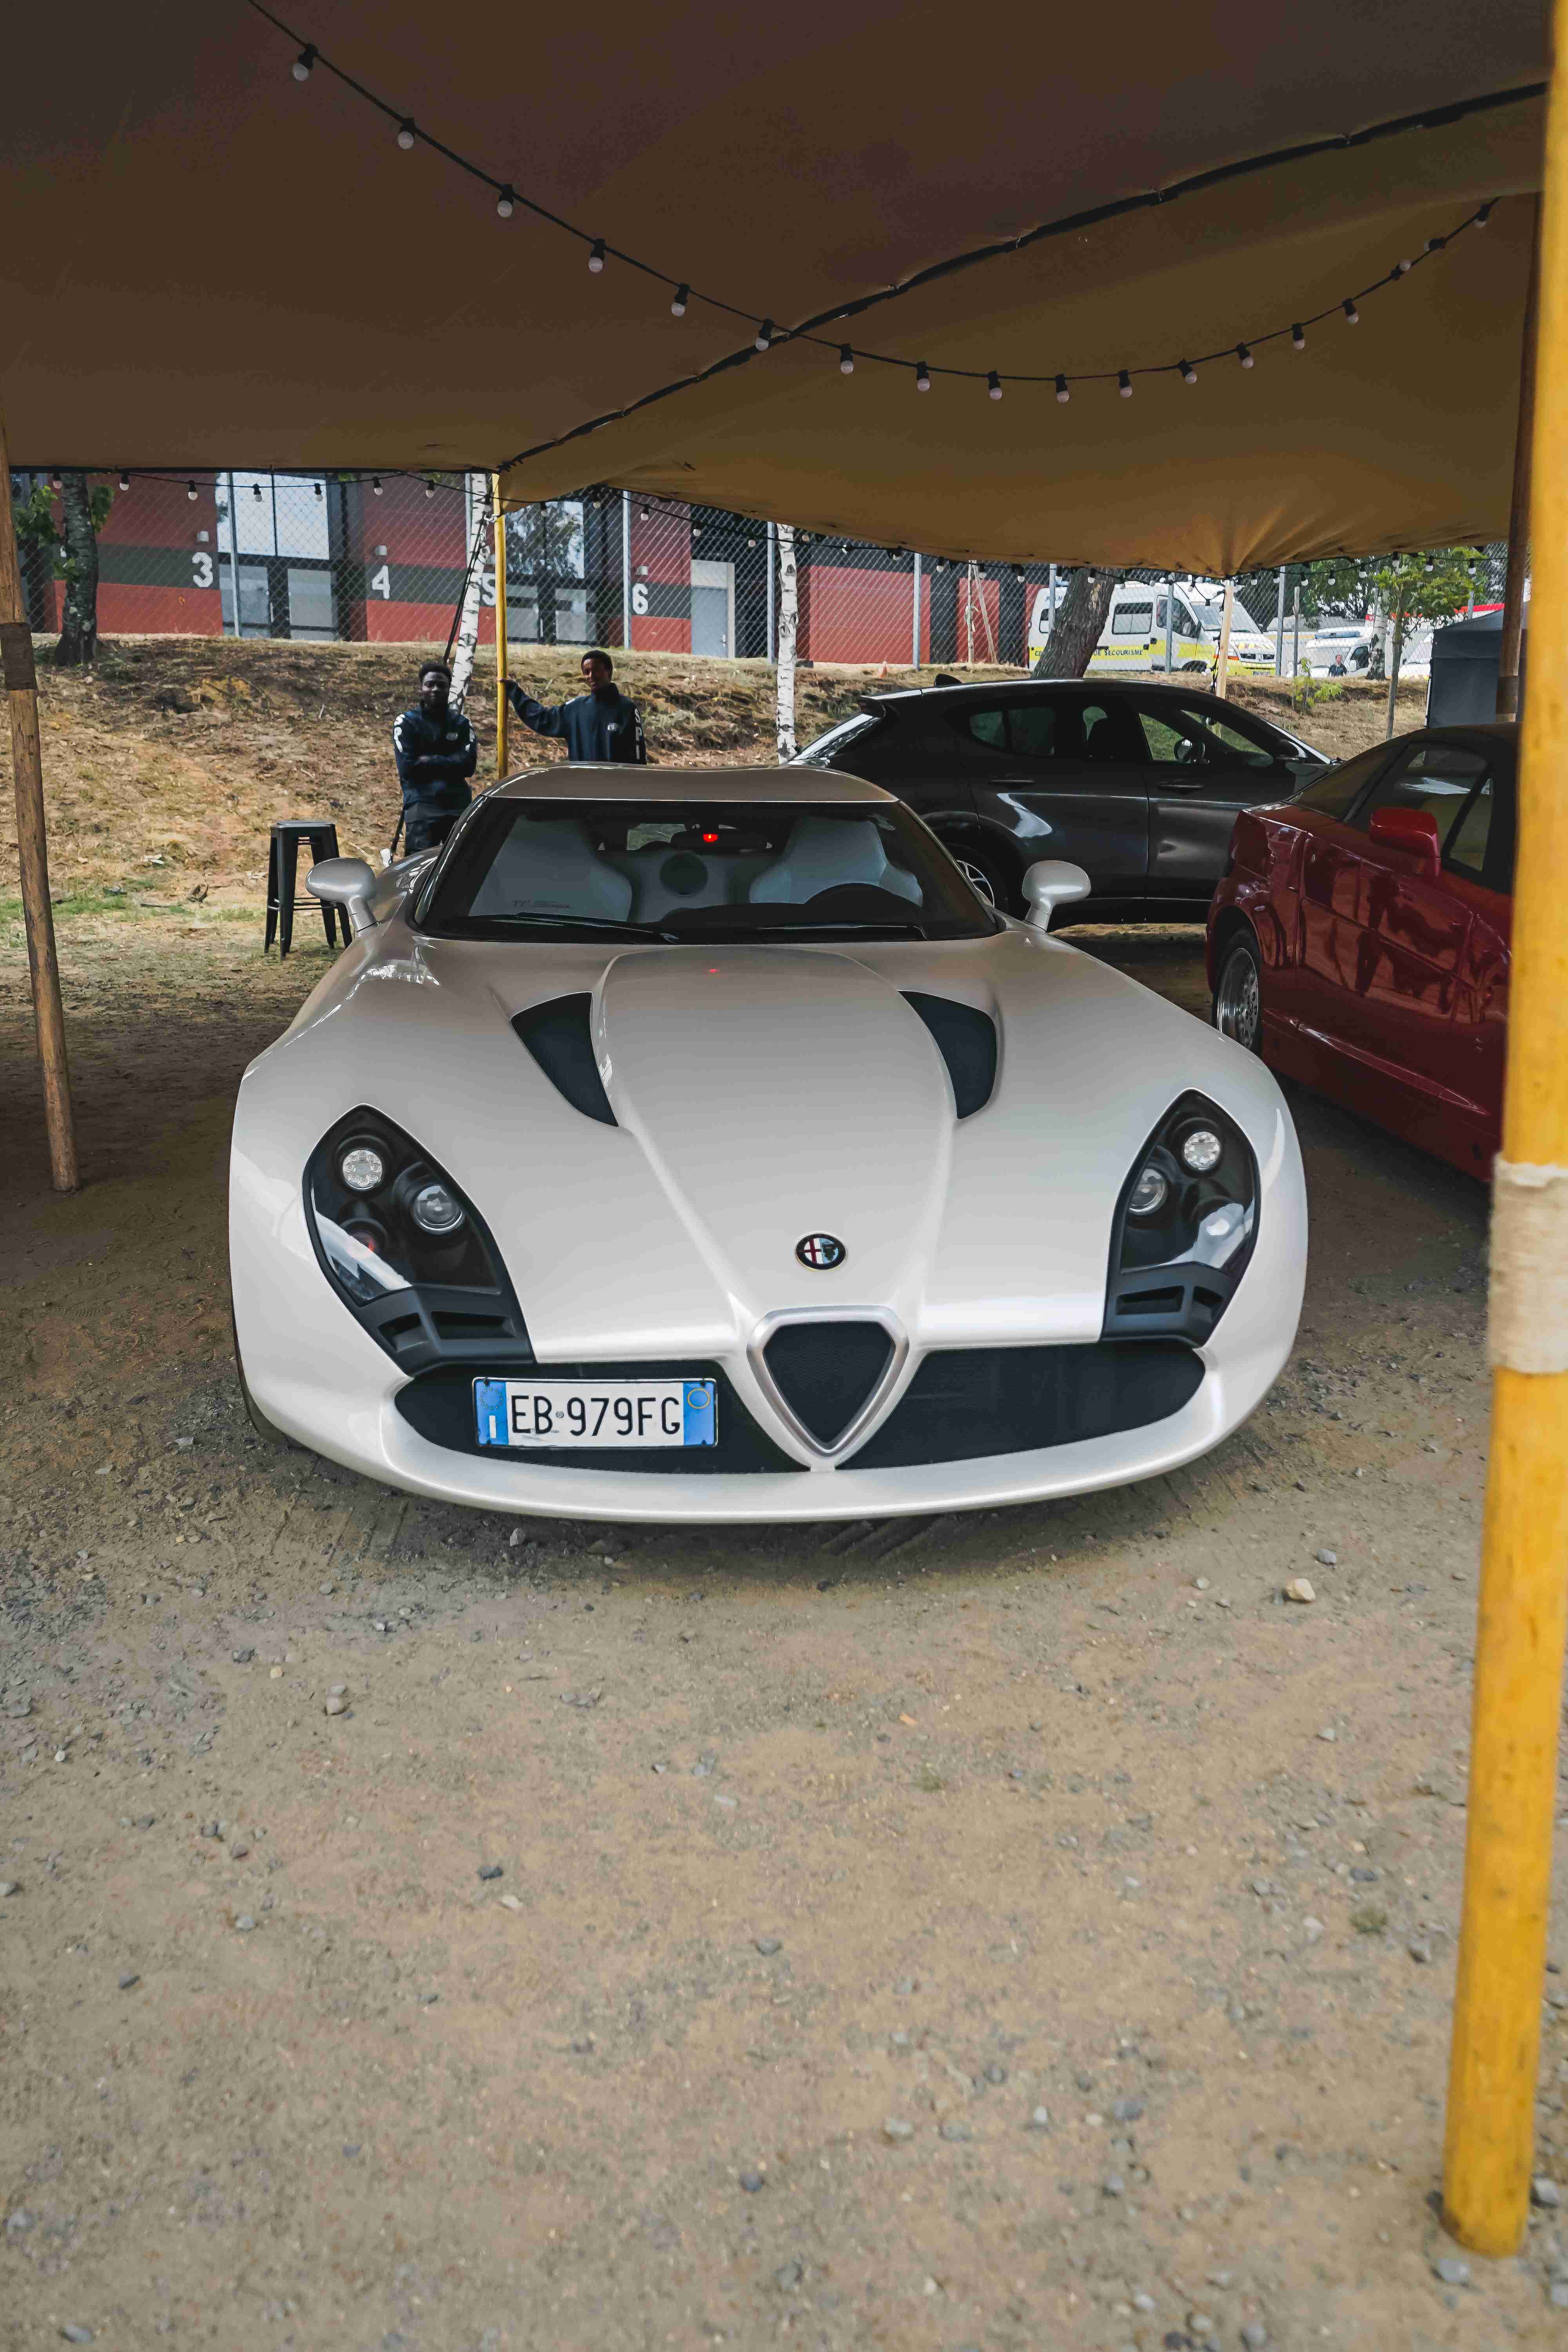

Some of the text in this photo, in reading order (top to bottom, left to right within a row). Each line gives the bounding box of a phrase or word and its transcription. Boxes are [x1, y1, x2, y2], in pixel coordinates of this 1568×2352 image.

[191, 552, 213, 588] 3
[371, 565, 390, 599] 4
[632, 583, 649, 615] 6
